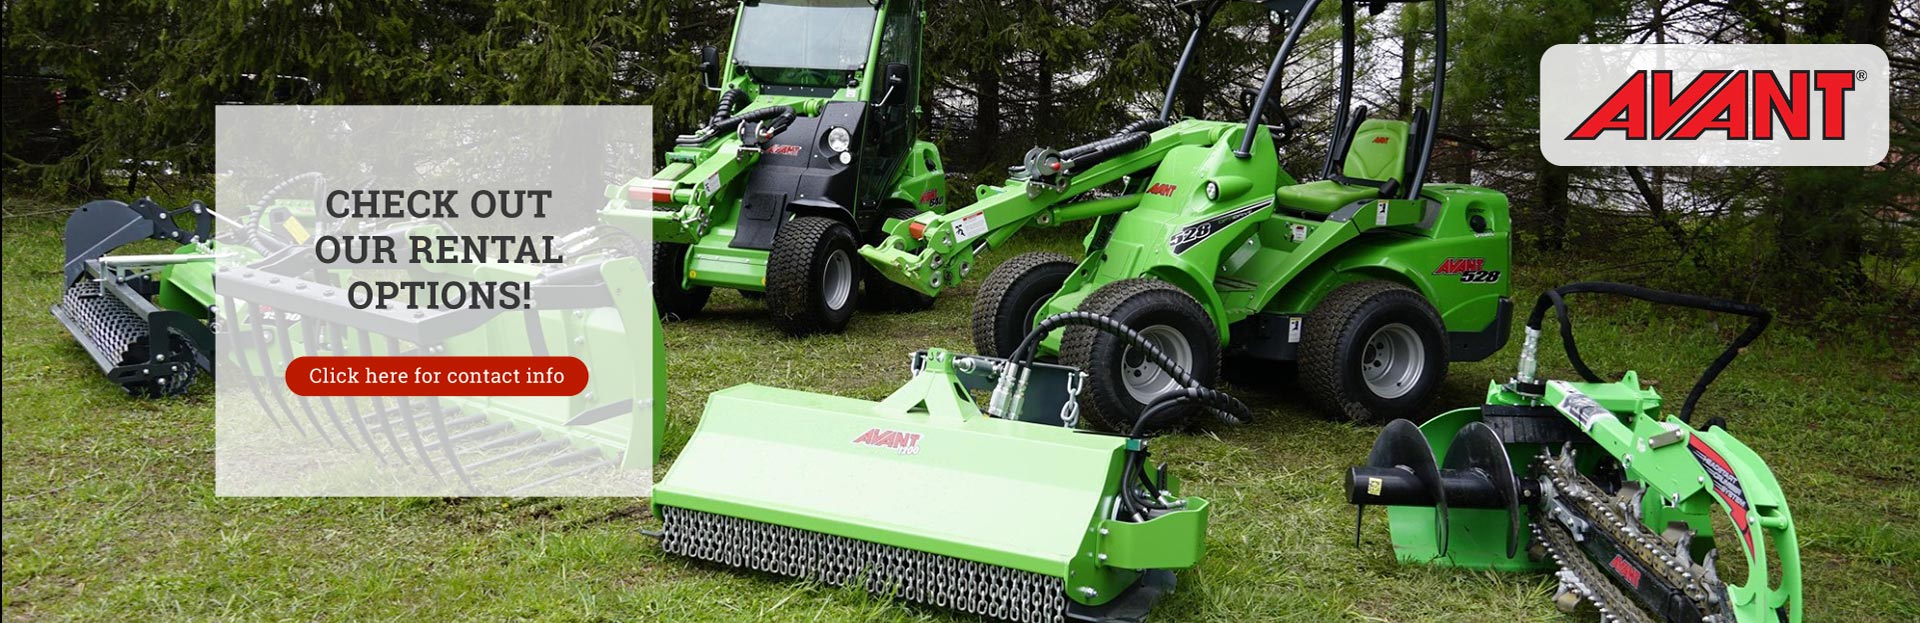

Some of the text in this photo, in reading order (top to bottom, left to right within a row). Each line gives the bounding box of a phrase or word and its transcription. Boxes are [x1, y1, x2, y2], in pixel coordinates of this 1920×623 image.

[1169, 222, 1212, 247] 528
[1432, 257, 1484, 276] AVANT
[1460, 270, 1501, 284] 528
[852, 428, 922, 449] AVANT
